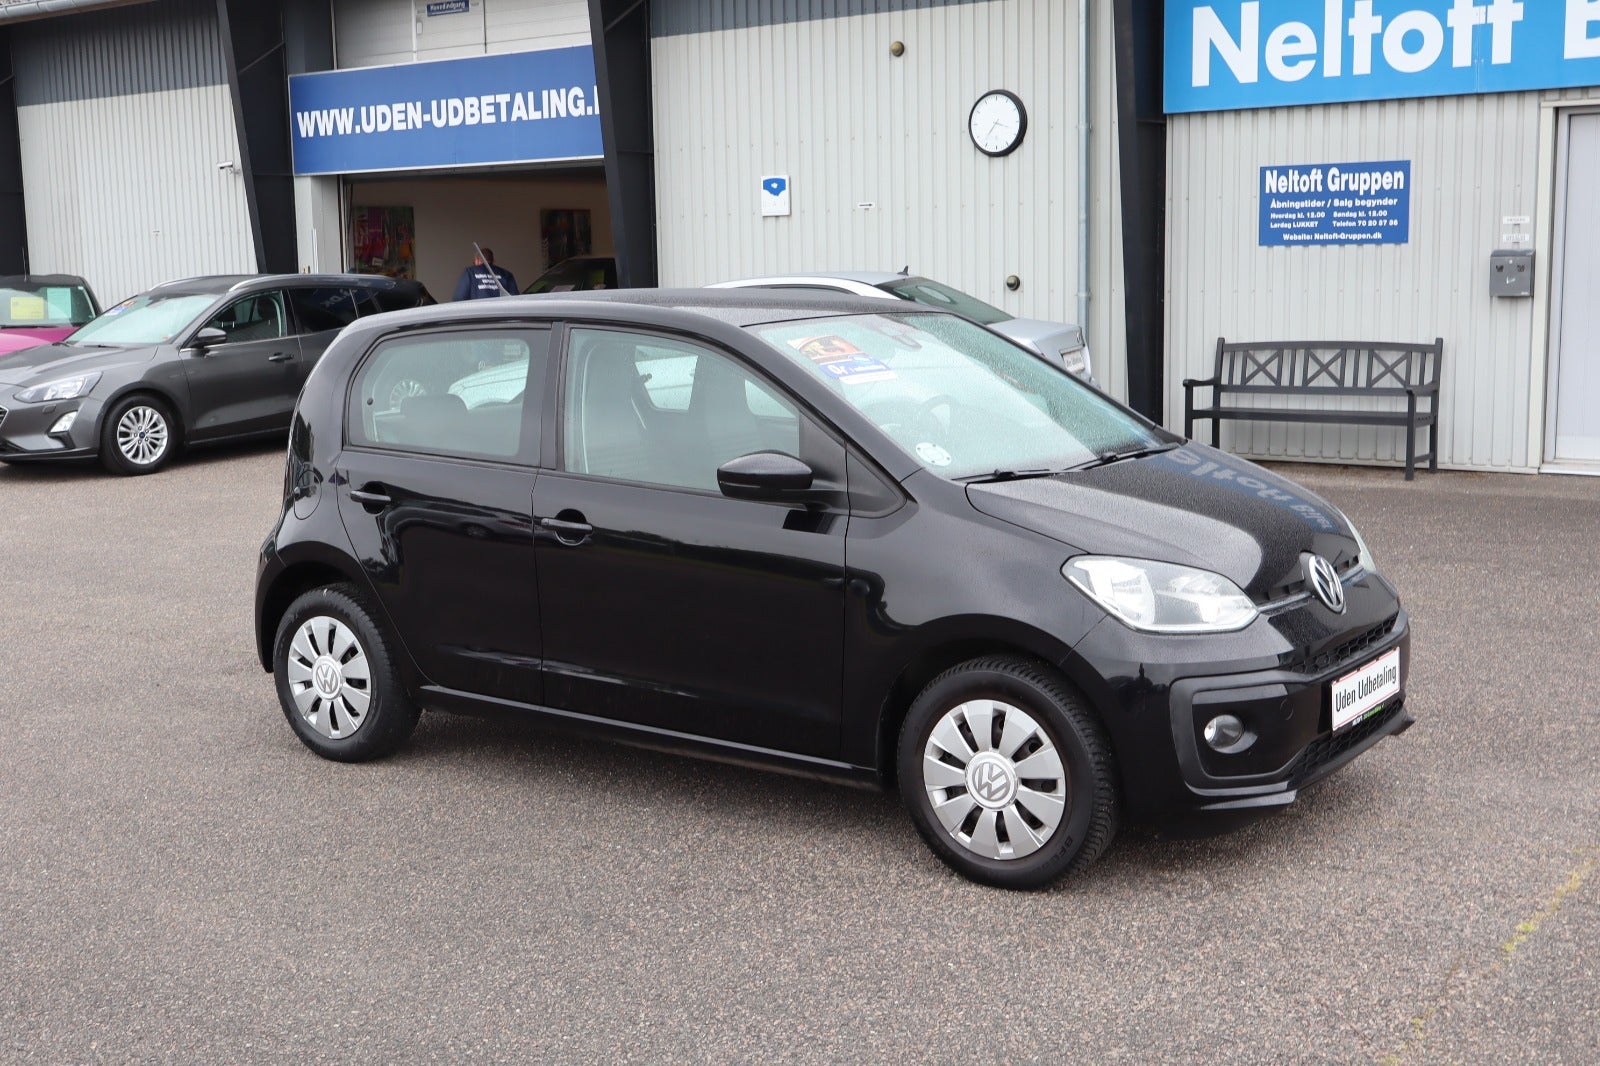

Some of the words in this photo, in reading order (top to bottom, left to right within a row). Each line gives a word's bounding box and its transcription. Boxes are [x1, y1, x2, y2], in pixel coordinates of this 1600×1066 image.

[1191, 0, 1523, 87] Neltoft
[1563, 0, 1600, 60] B
[1265, 168, 1323, 193] Neltoft
[1327, 167, 1404, 195] Gruppen
[1270, 198, 1325, 209] Åbningstider
[1333, 198, 1353, 208] Salg
[1355, 197, 1398, 208] begynder
[1314, 232, 1382, 240] Neltoft-Gruppen.dk
[1335, 688, 1356, 713] Uden
[1358, 665, 1397, 700] Udbetaling
